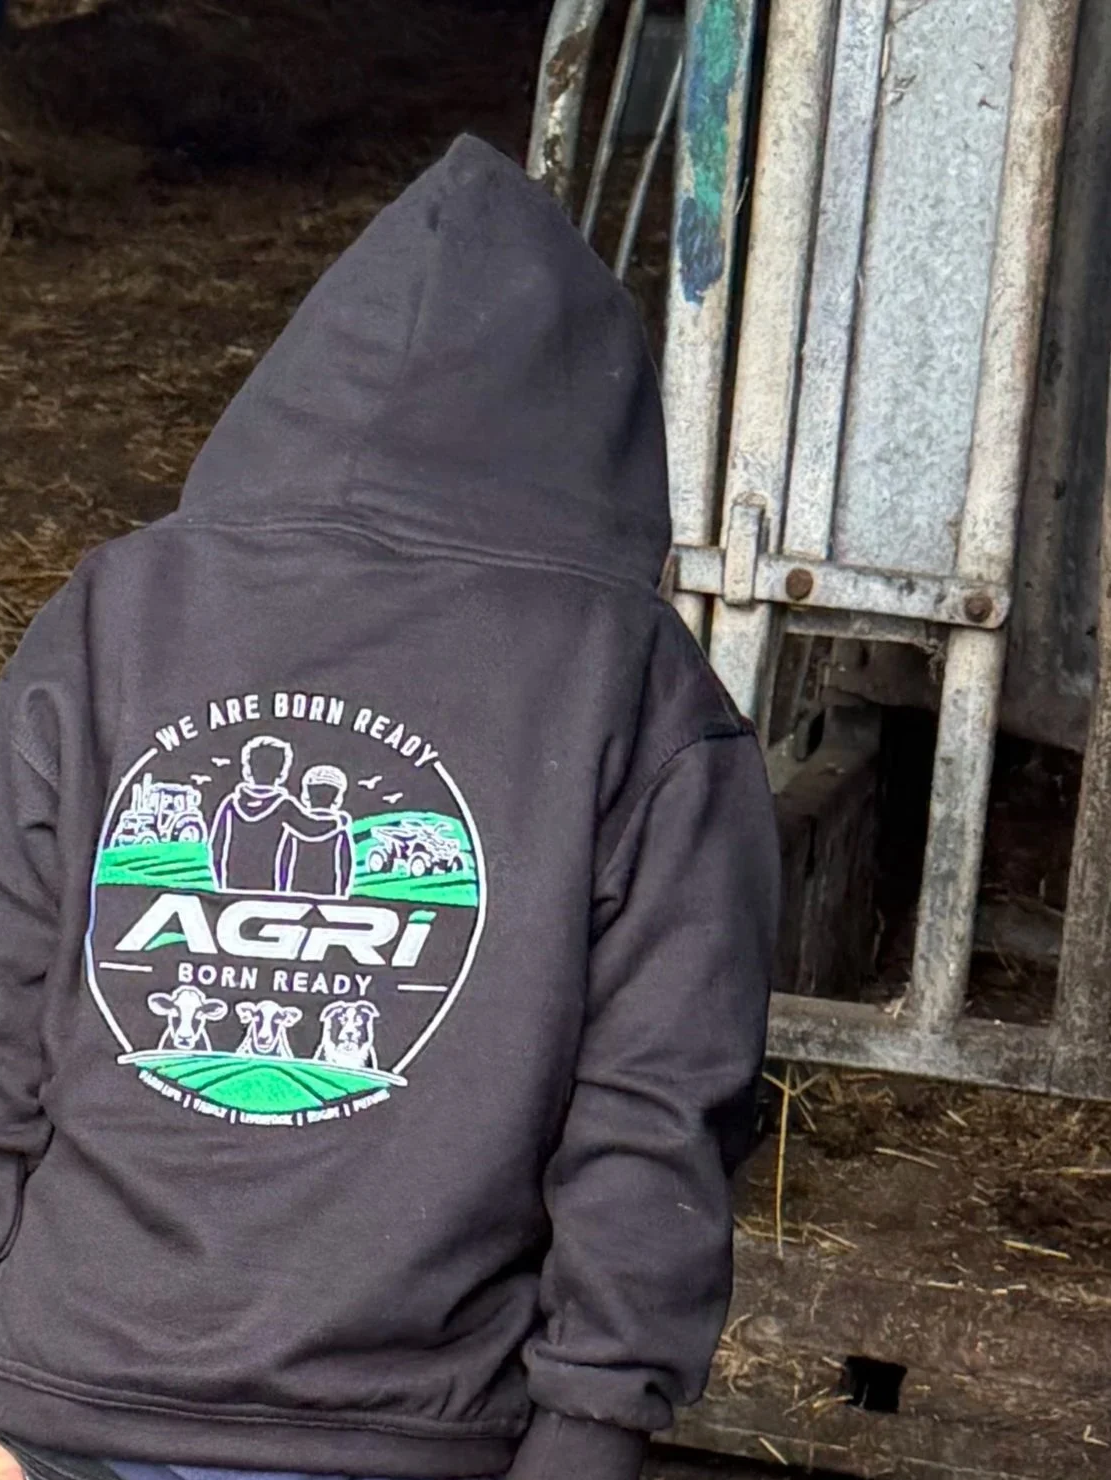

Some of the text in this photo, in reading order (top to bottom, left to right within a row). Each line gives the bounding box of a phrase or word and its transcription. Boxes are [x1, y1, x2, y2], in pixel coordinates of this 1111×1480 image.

[155, 692, 439, 768] WE ARE BORN READY
[178, 961, 374, 996] BORN READY
